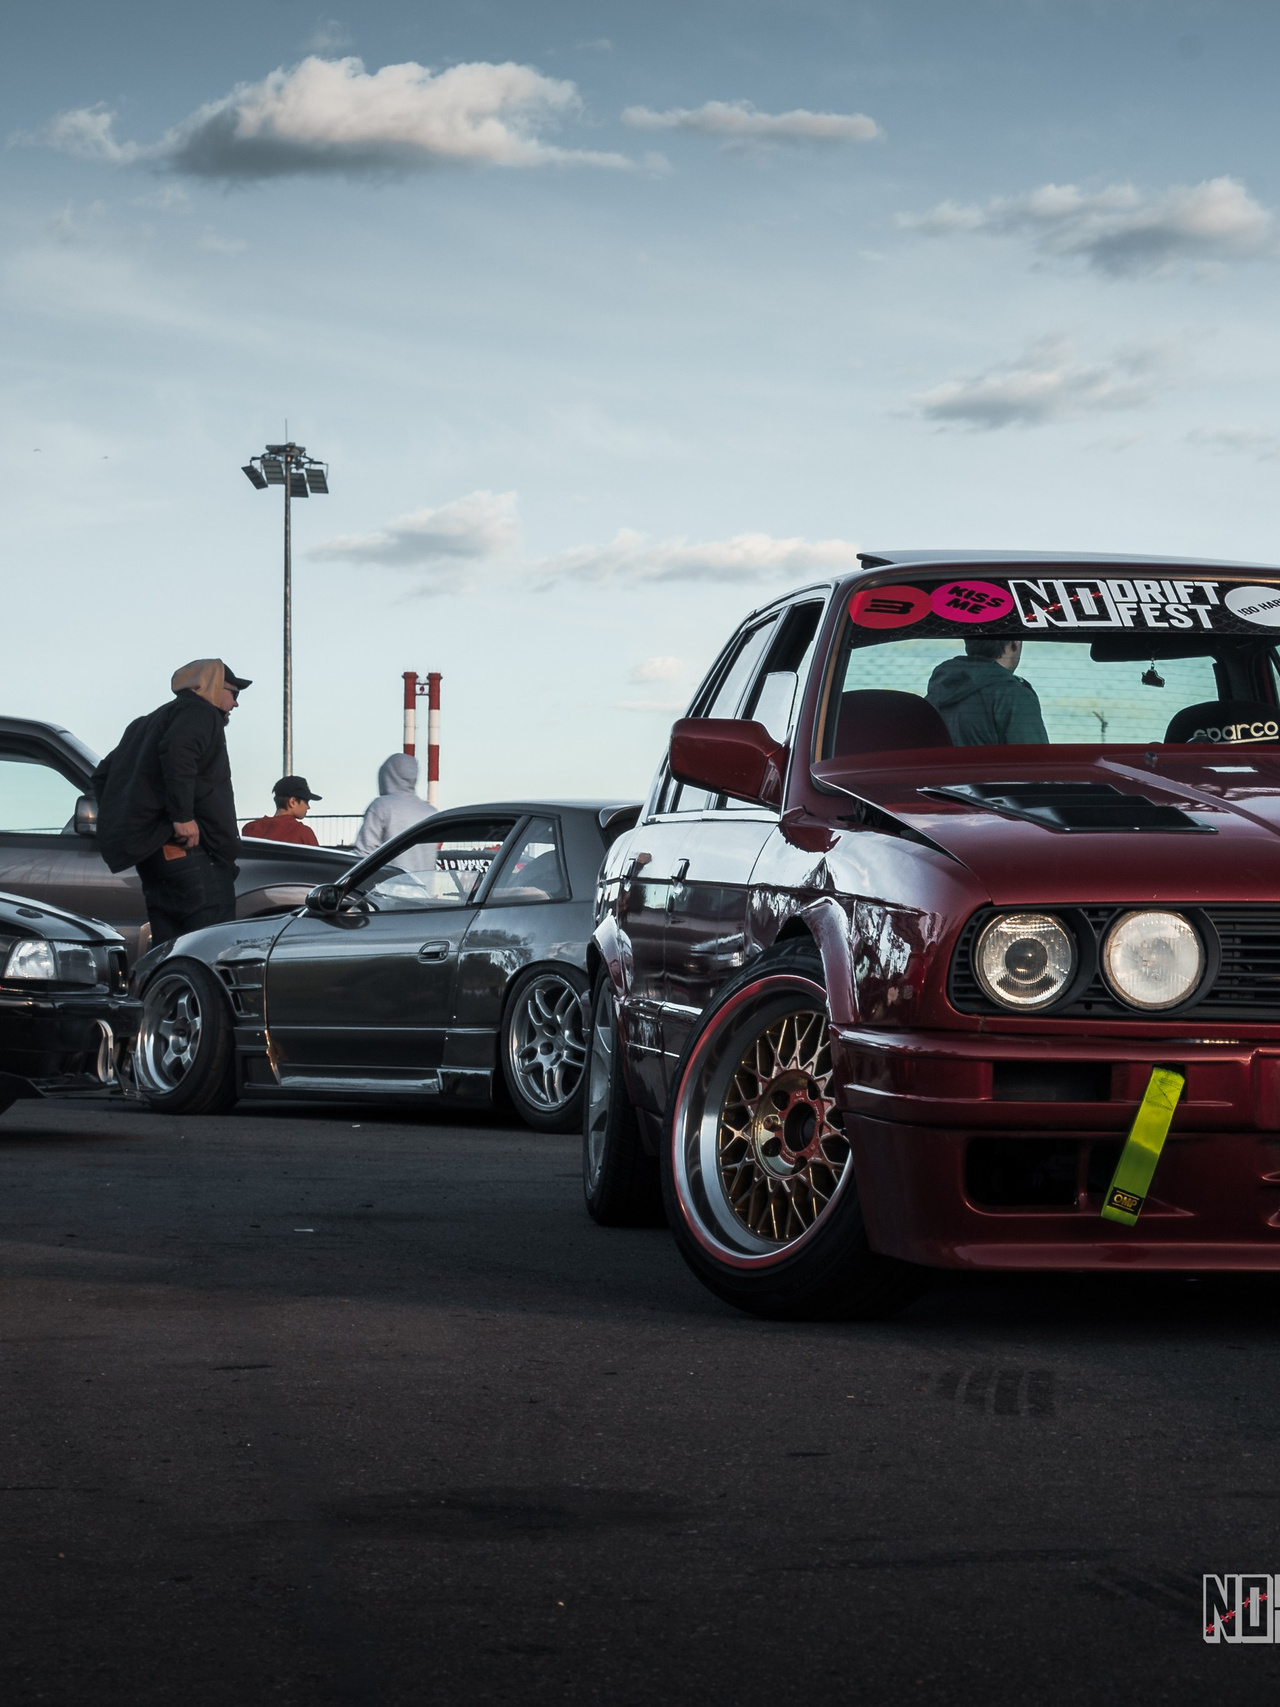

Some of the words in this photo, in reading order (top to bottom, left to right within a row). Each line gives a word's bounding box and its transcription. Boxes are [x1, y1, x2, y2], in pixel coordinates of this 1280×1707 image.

[948, 585, 1005, 608] KISS
[1106, 580, 1220, 605] DRIFT
[945, 598, 987, 615] ME
[1115, 603, 1214, 629] FEST
[1113, 1193, 1138, 1208] OMP
